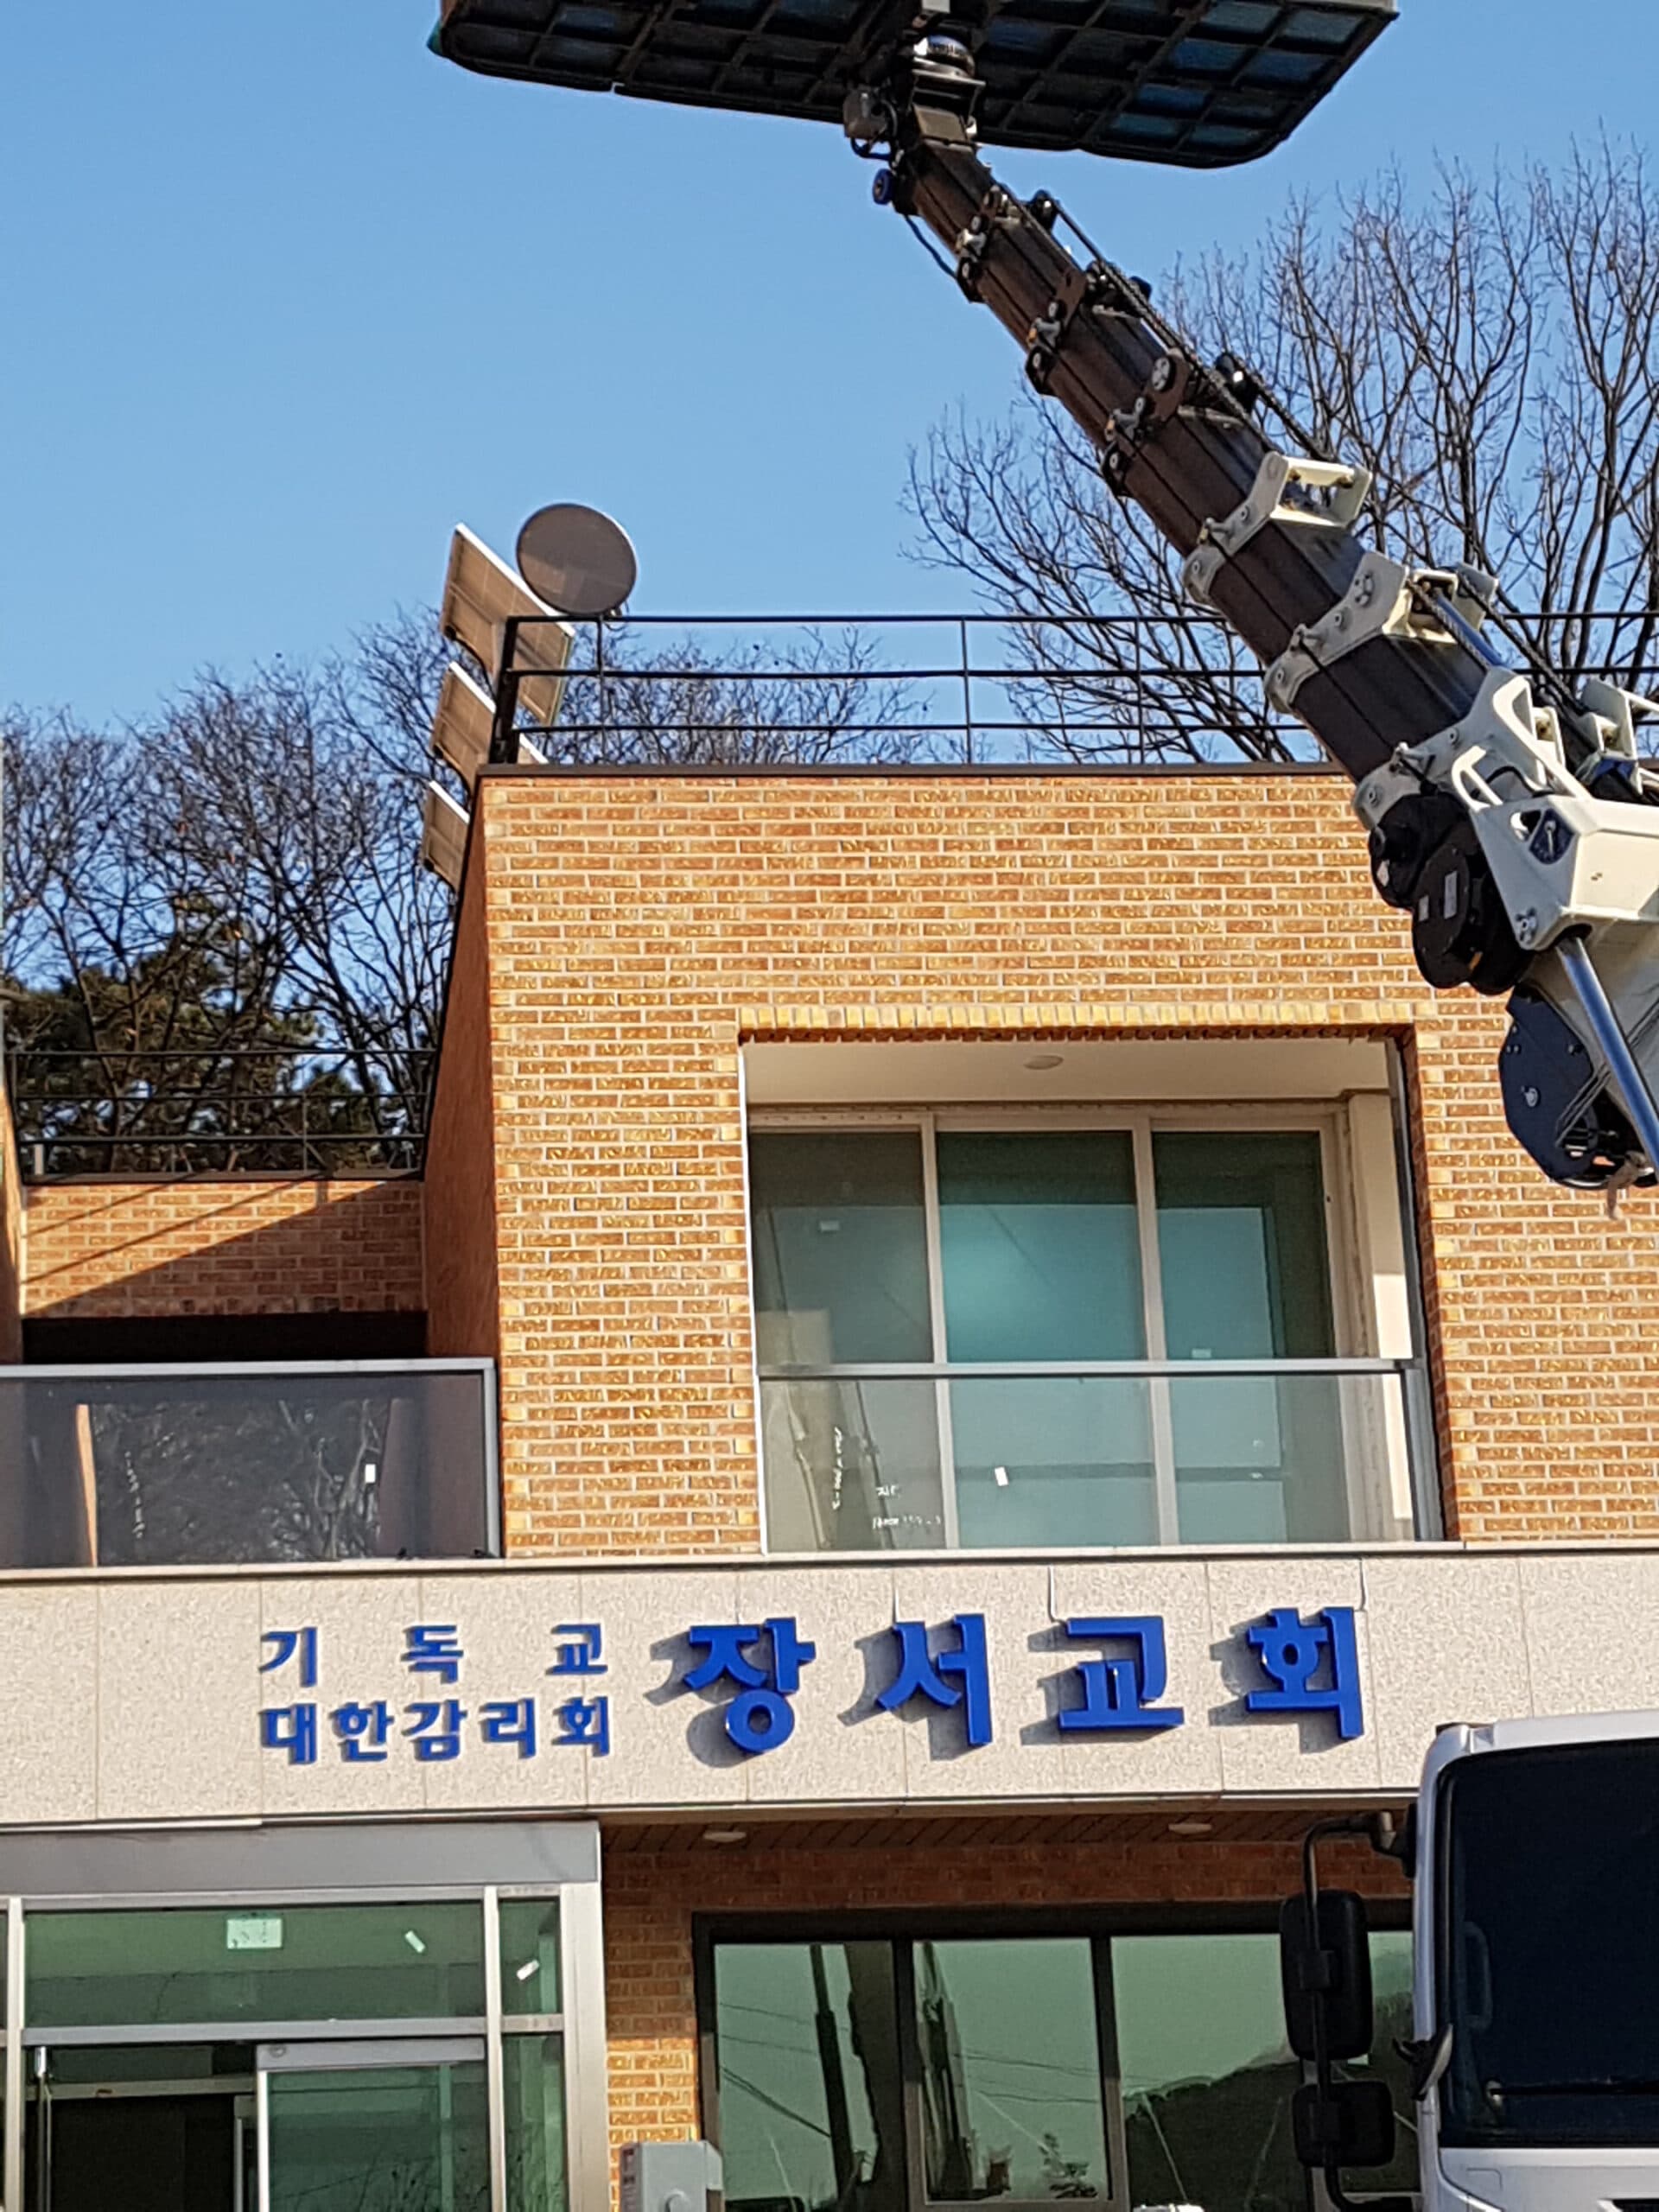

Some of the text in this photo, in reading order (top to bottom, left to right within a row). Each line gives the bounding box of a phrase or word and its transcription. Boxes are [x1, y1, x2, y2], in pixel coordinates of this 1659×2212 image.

[260, 1624, 607, 1687] 기독교
[682, 1607, 1363, 1756] 장서교회
[262, 1696, 610, 1764] 대한감리회
